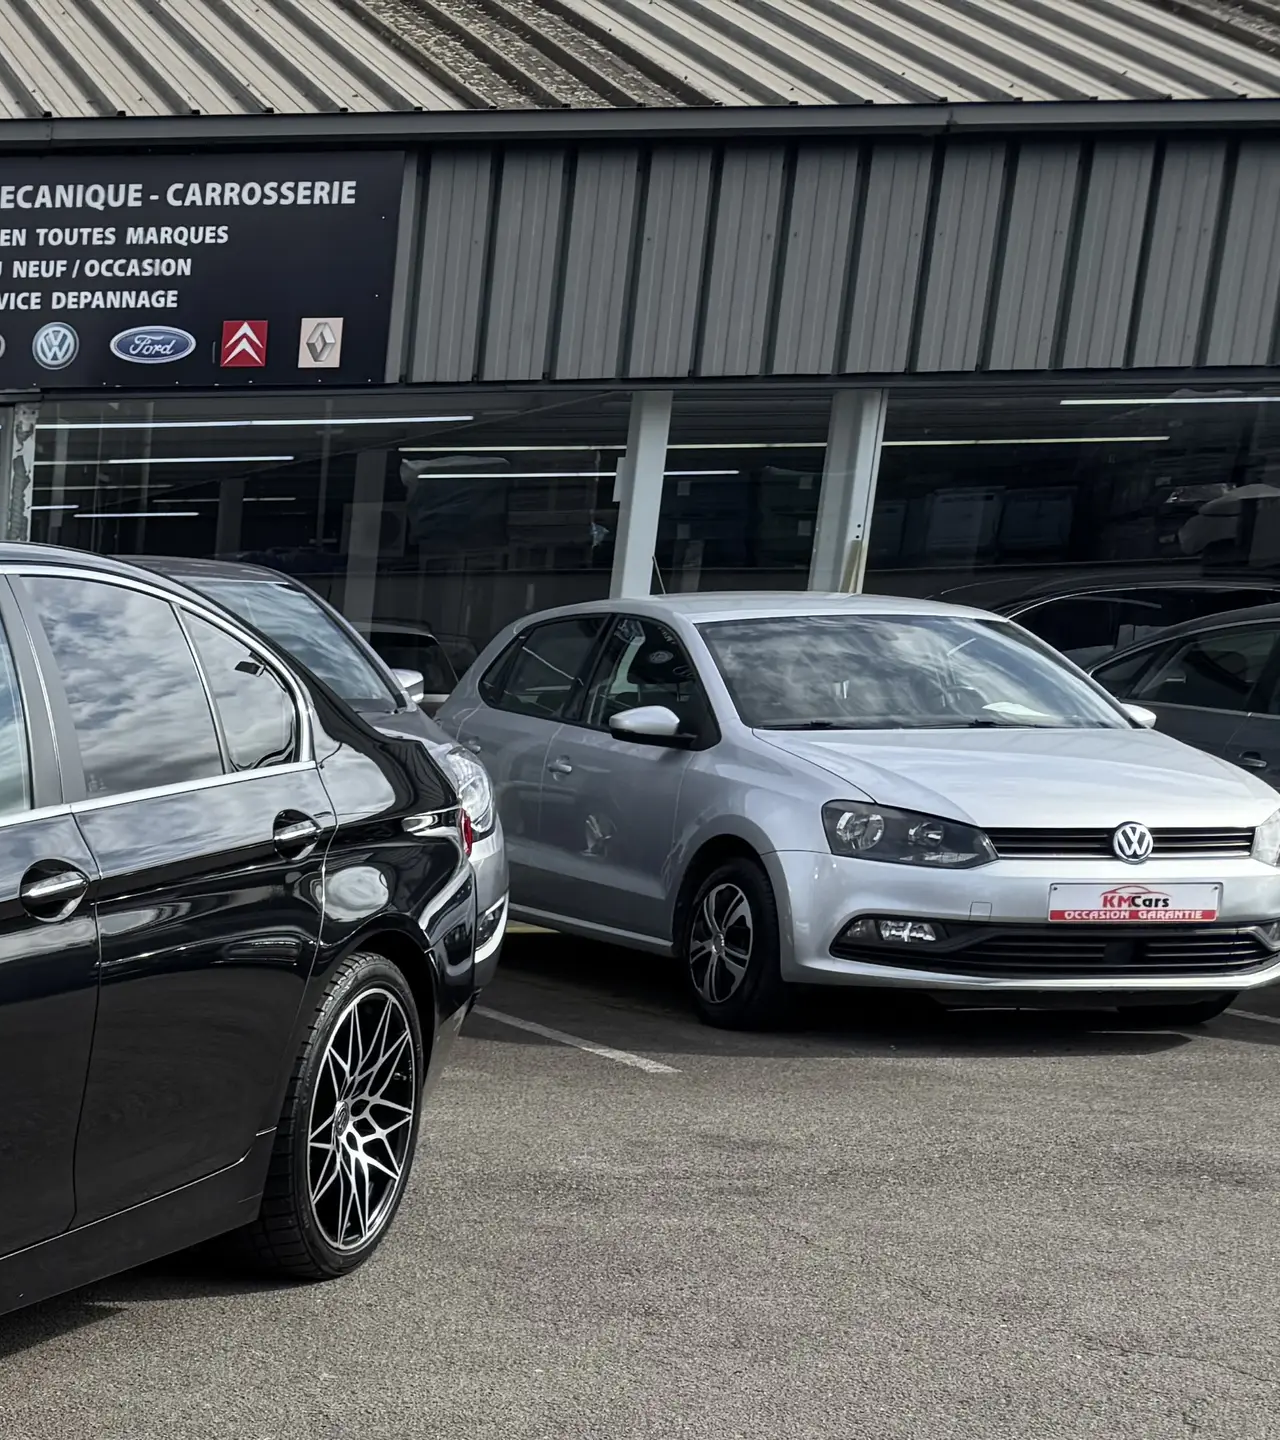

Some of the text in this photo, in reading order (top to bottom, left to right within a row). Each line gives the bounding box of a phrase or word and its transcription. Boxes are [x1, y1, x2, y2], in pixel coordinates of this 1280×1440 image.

[166, 180, 357, 209] CARROSSERIE
[36, 227, 116, 246] TOUTES
[125, 225, 229, 246] MARQUES
[51, 291, 178, 310] DEPANNAGE
[128, 333, 177, 356] Ford
[1101, 895, 1170, 909] KMCars
[1063, 909, 1203, 920] OCCASION GARANTIE
